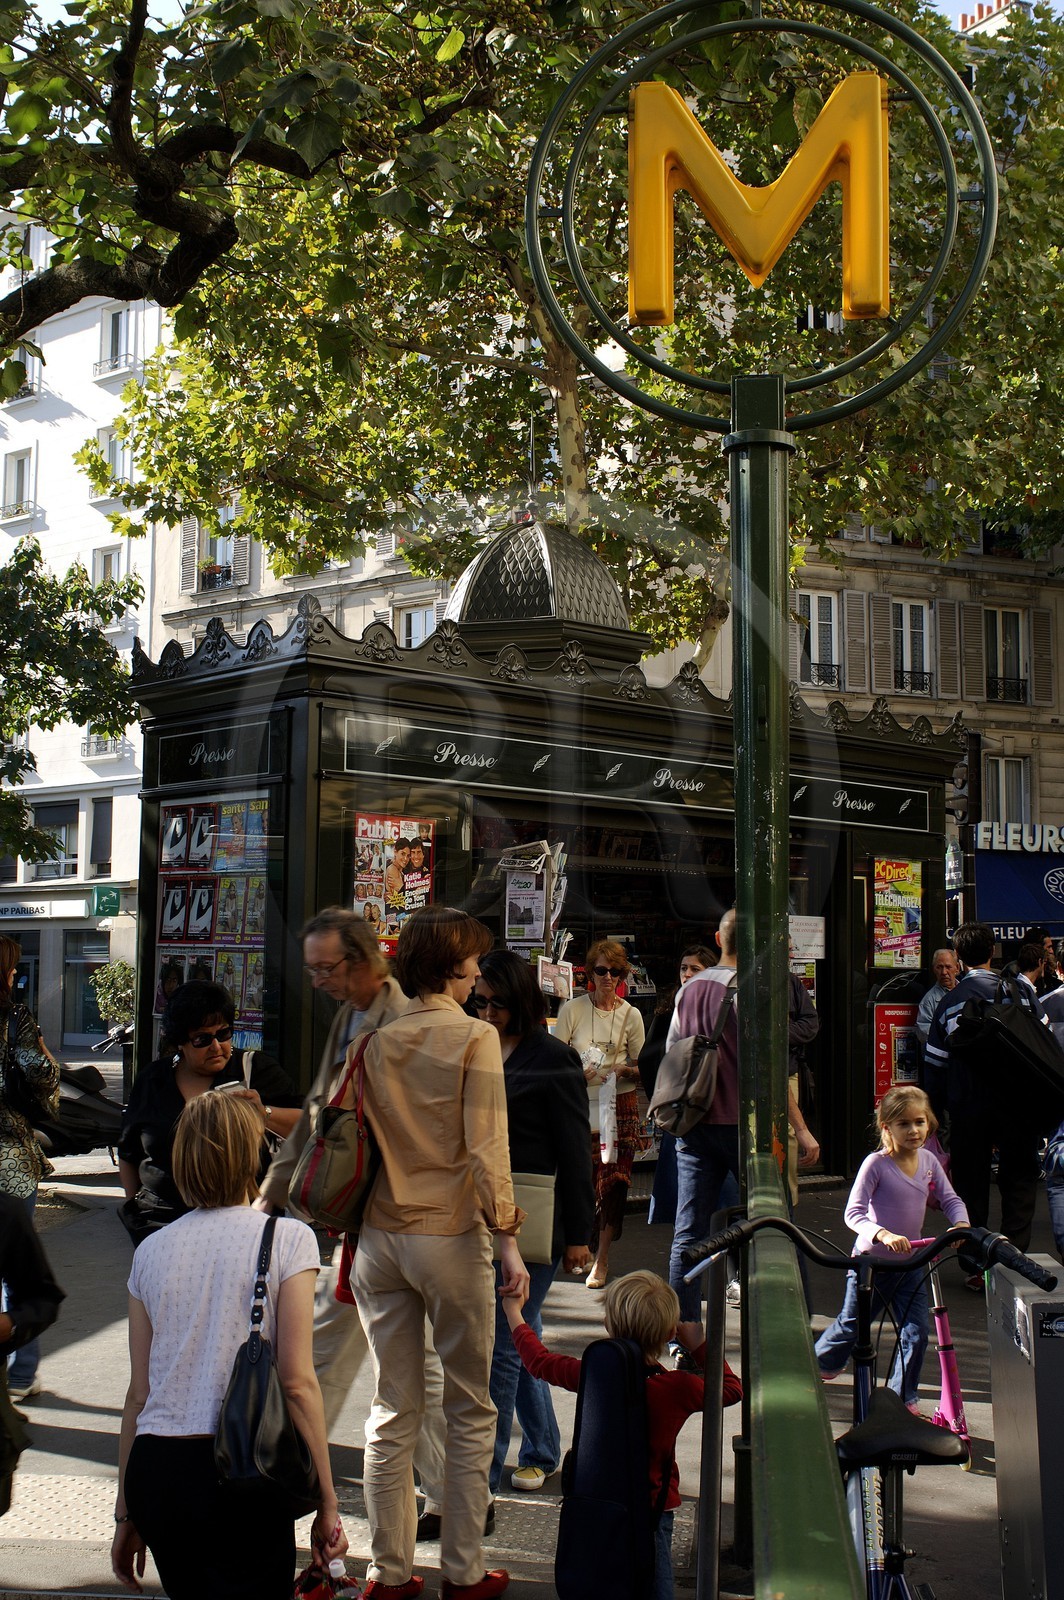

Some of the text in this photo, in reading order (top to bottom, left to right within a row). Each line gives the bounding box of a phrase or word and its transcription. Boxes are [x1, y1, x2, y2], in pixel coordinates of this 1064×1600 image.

[627, 70, 889, 326] M
[188, 742, 236, 766] Presse
[433, 741, 499, 769] Presse
[653, 768, 706, 792] Presse
[832, 789, 876, 812] Presse
[357, 818, 400, 840] Public
[875, 861, 887, 878] PC
[11, 906, 45, 915] PARIBAS
[993, 926, 1041, 940] FLEU
